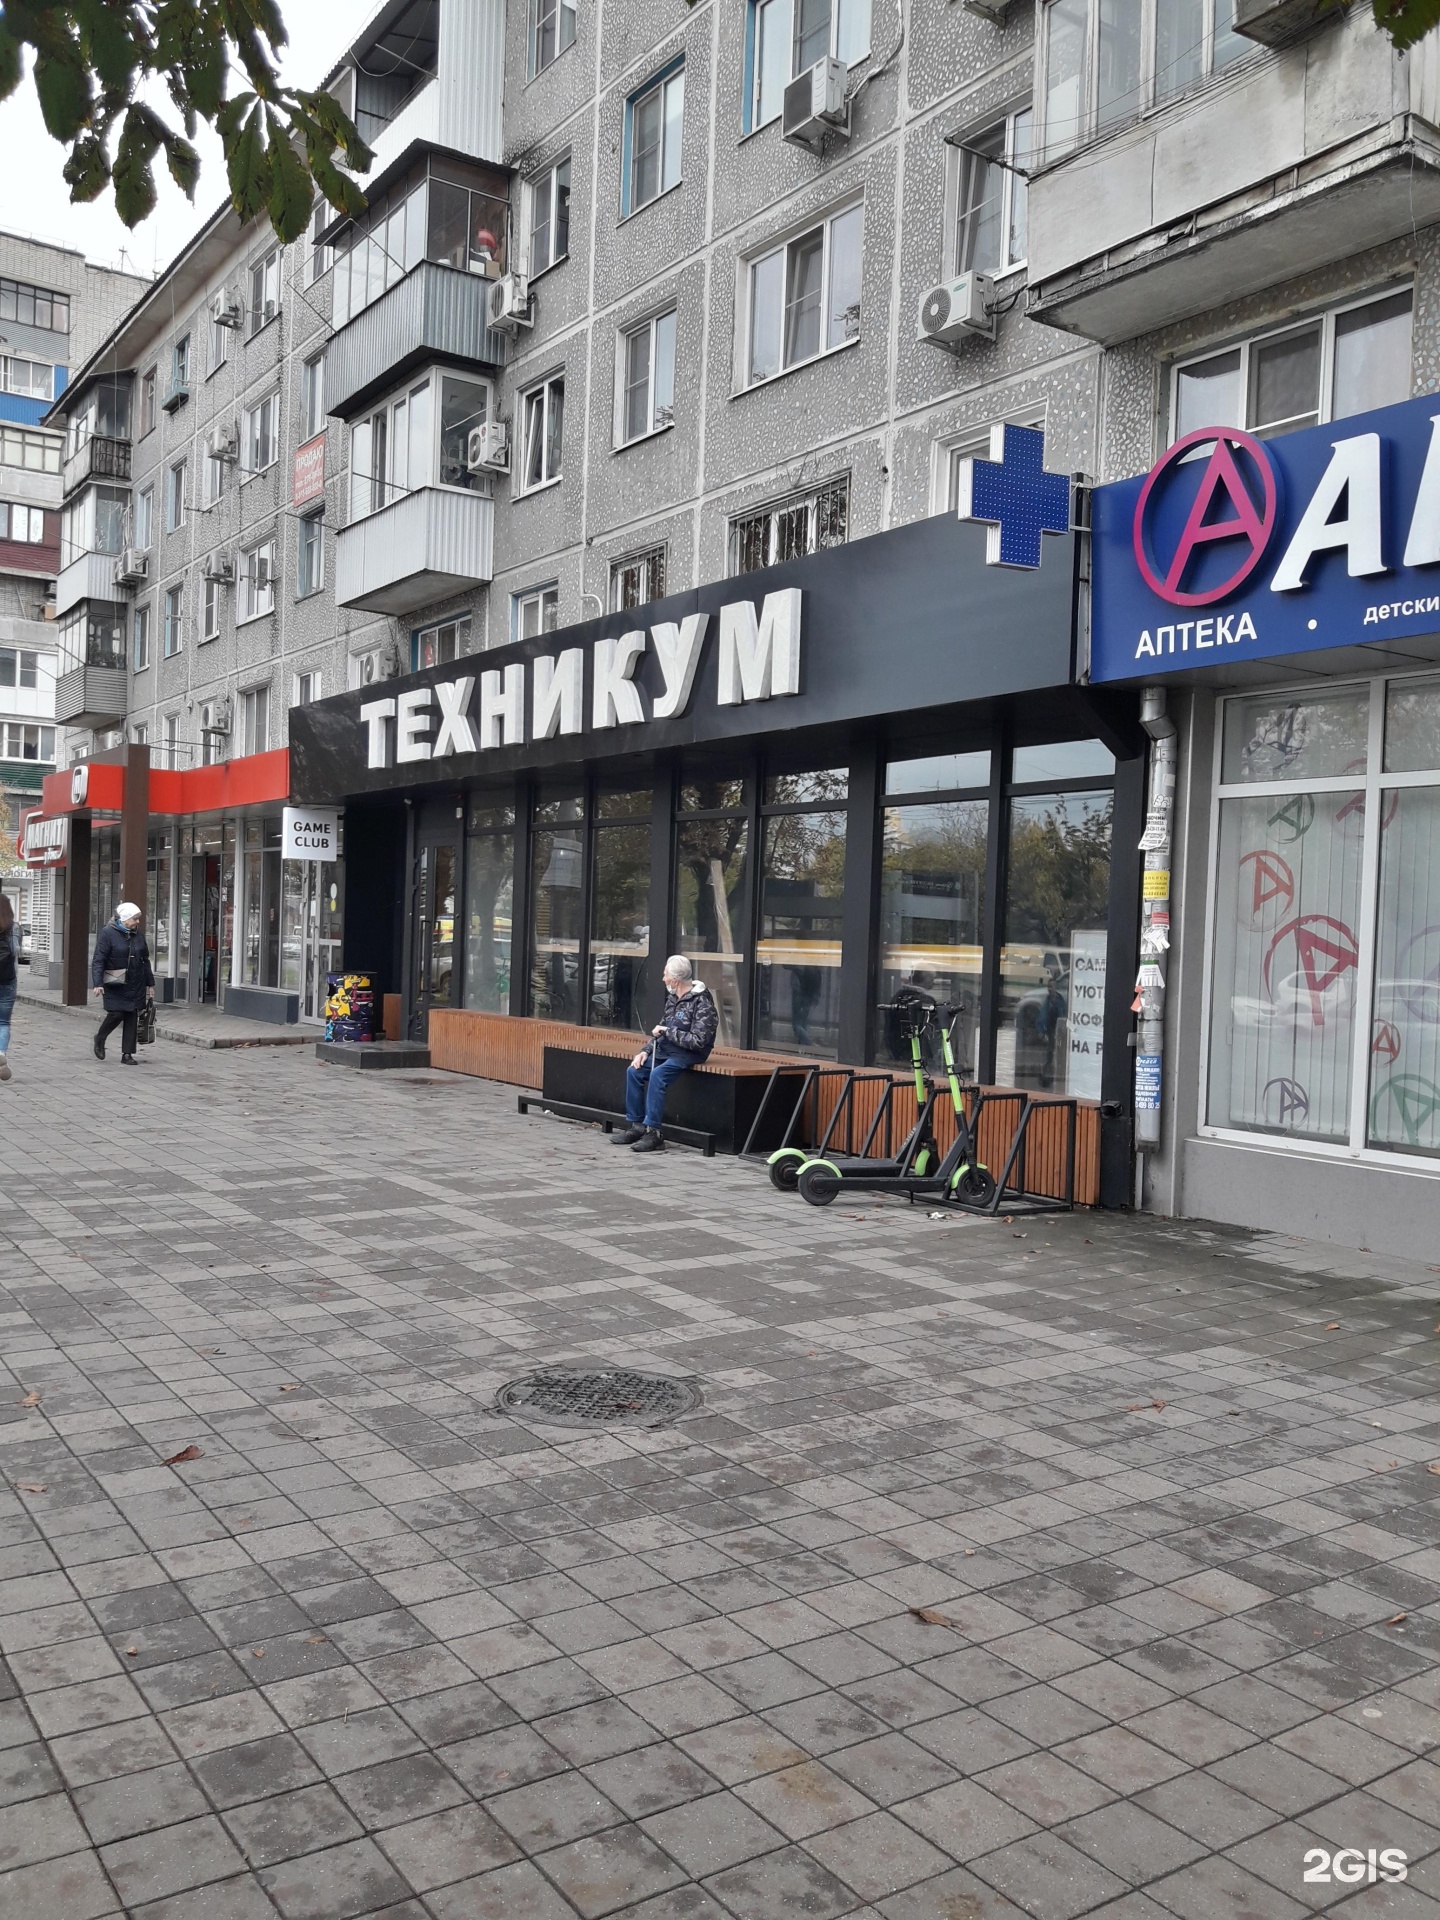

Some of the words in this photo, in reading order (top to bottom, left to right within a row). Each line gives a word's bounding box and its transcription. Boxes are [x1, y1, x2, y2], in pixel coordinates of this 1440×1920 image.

[296, 444, 323, 472] ПРОДАЮ
[1363, 595, 1440, 626] детски
[1135, 612, 1258, 659] АПТЕКА
[360, 587, 803, 769] ТЕХНИКУМ
[26, 818, 63, 850] МАГНИТ
[293, 821, 331, 834] GAME
[294, 836, 330, 849] CLUB
[1074, 984, 1104, 1000] УЮТ
[1072, 1012, 1103, 1027] КОФ
[1071, 1039, 1090, 1054] НА
